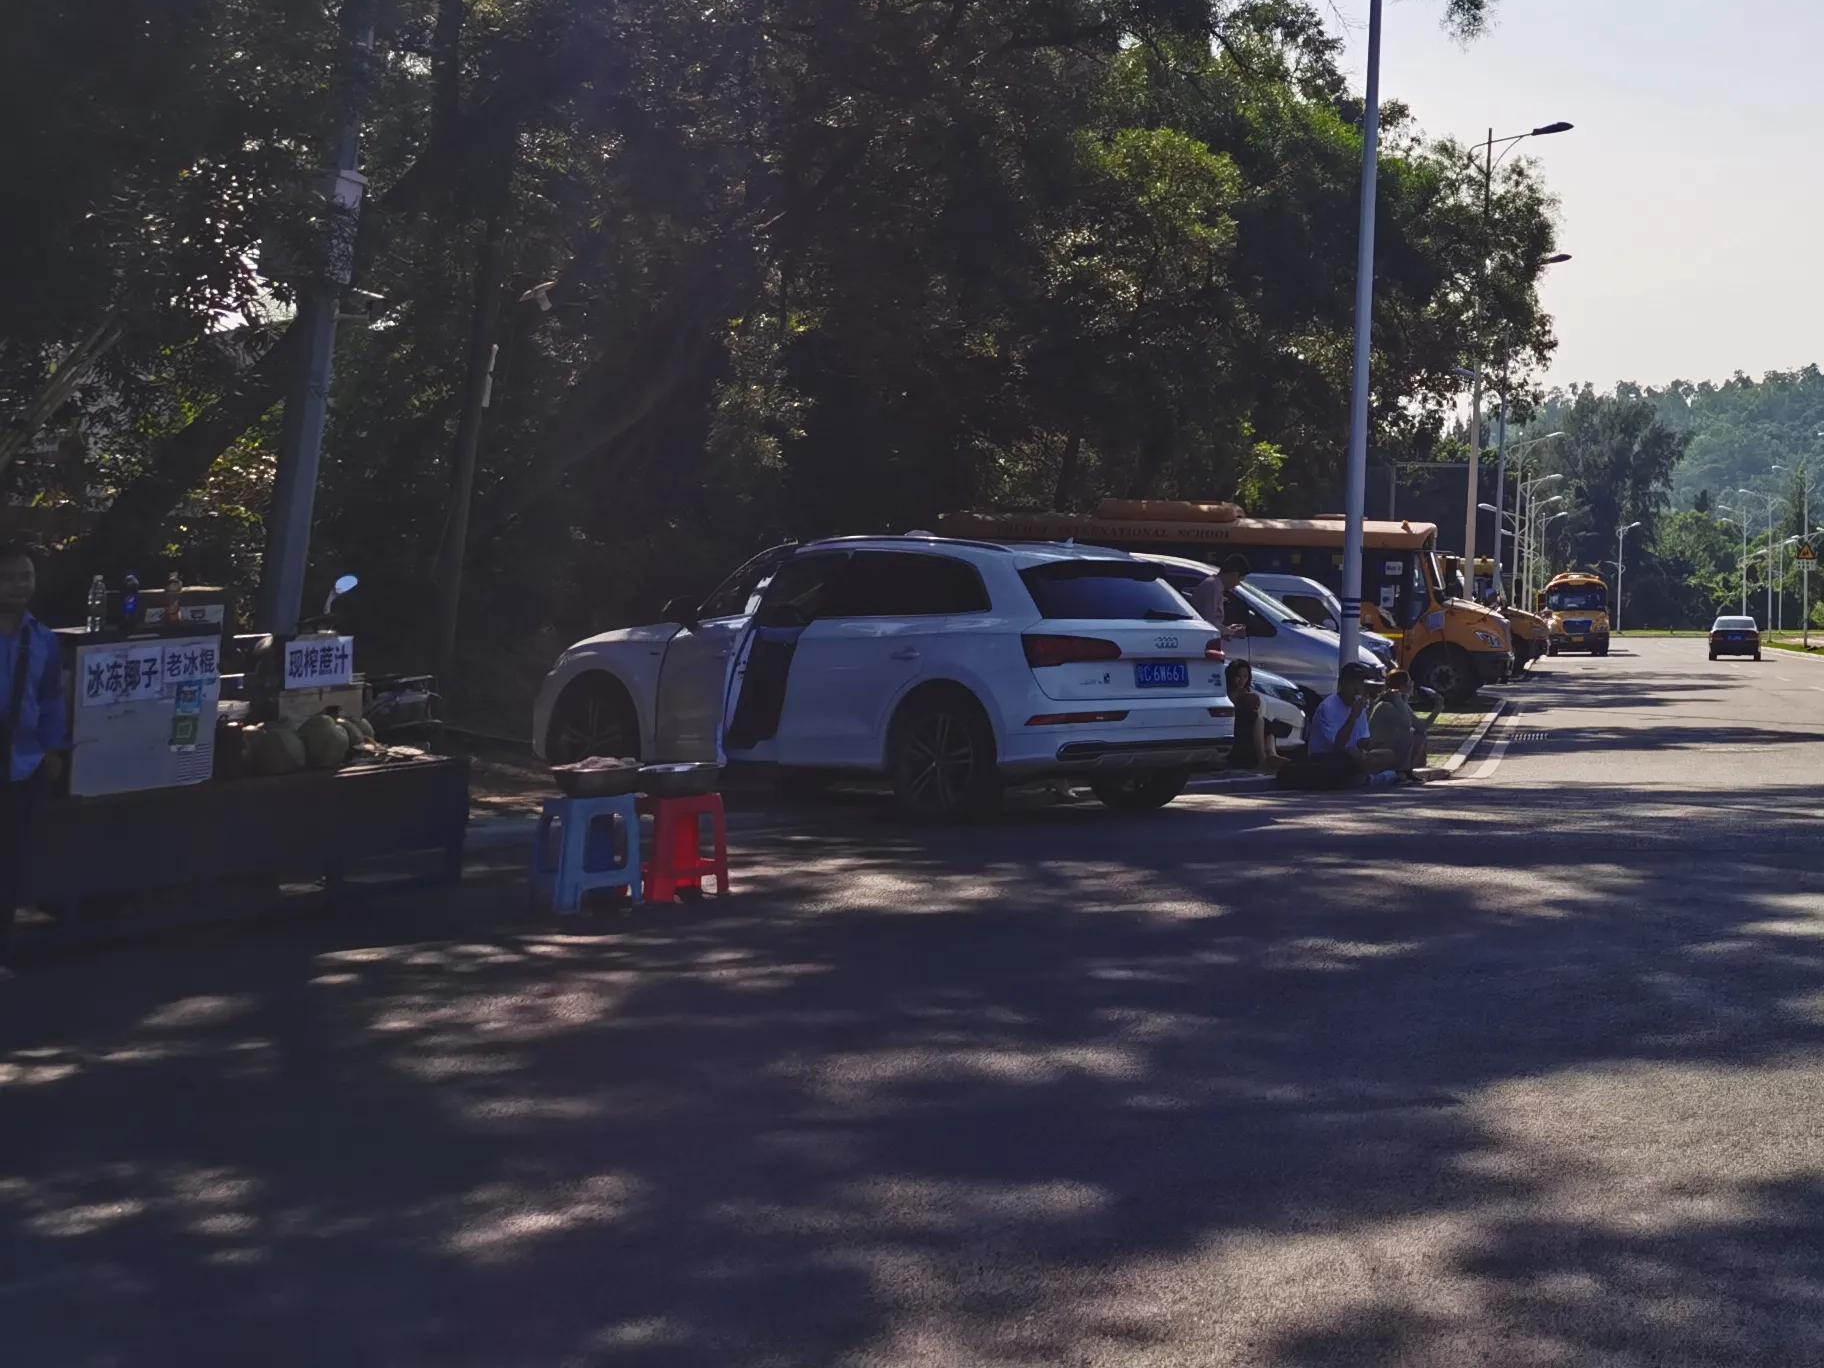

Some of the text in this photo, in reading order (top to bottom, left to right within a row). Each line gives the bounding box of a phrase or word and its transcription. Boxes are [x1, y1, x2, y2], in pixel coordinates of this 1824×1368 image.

[167, 649, 215, 677] 老冰棍
[288, 644, 349, 678] 现榨蔗汁
